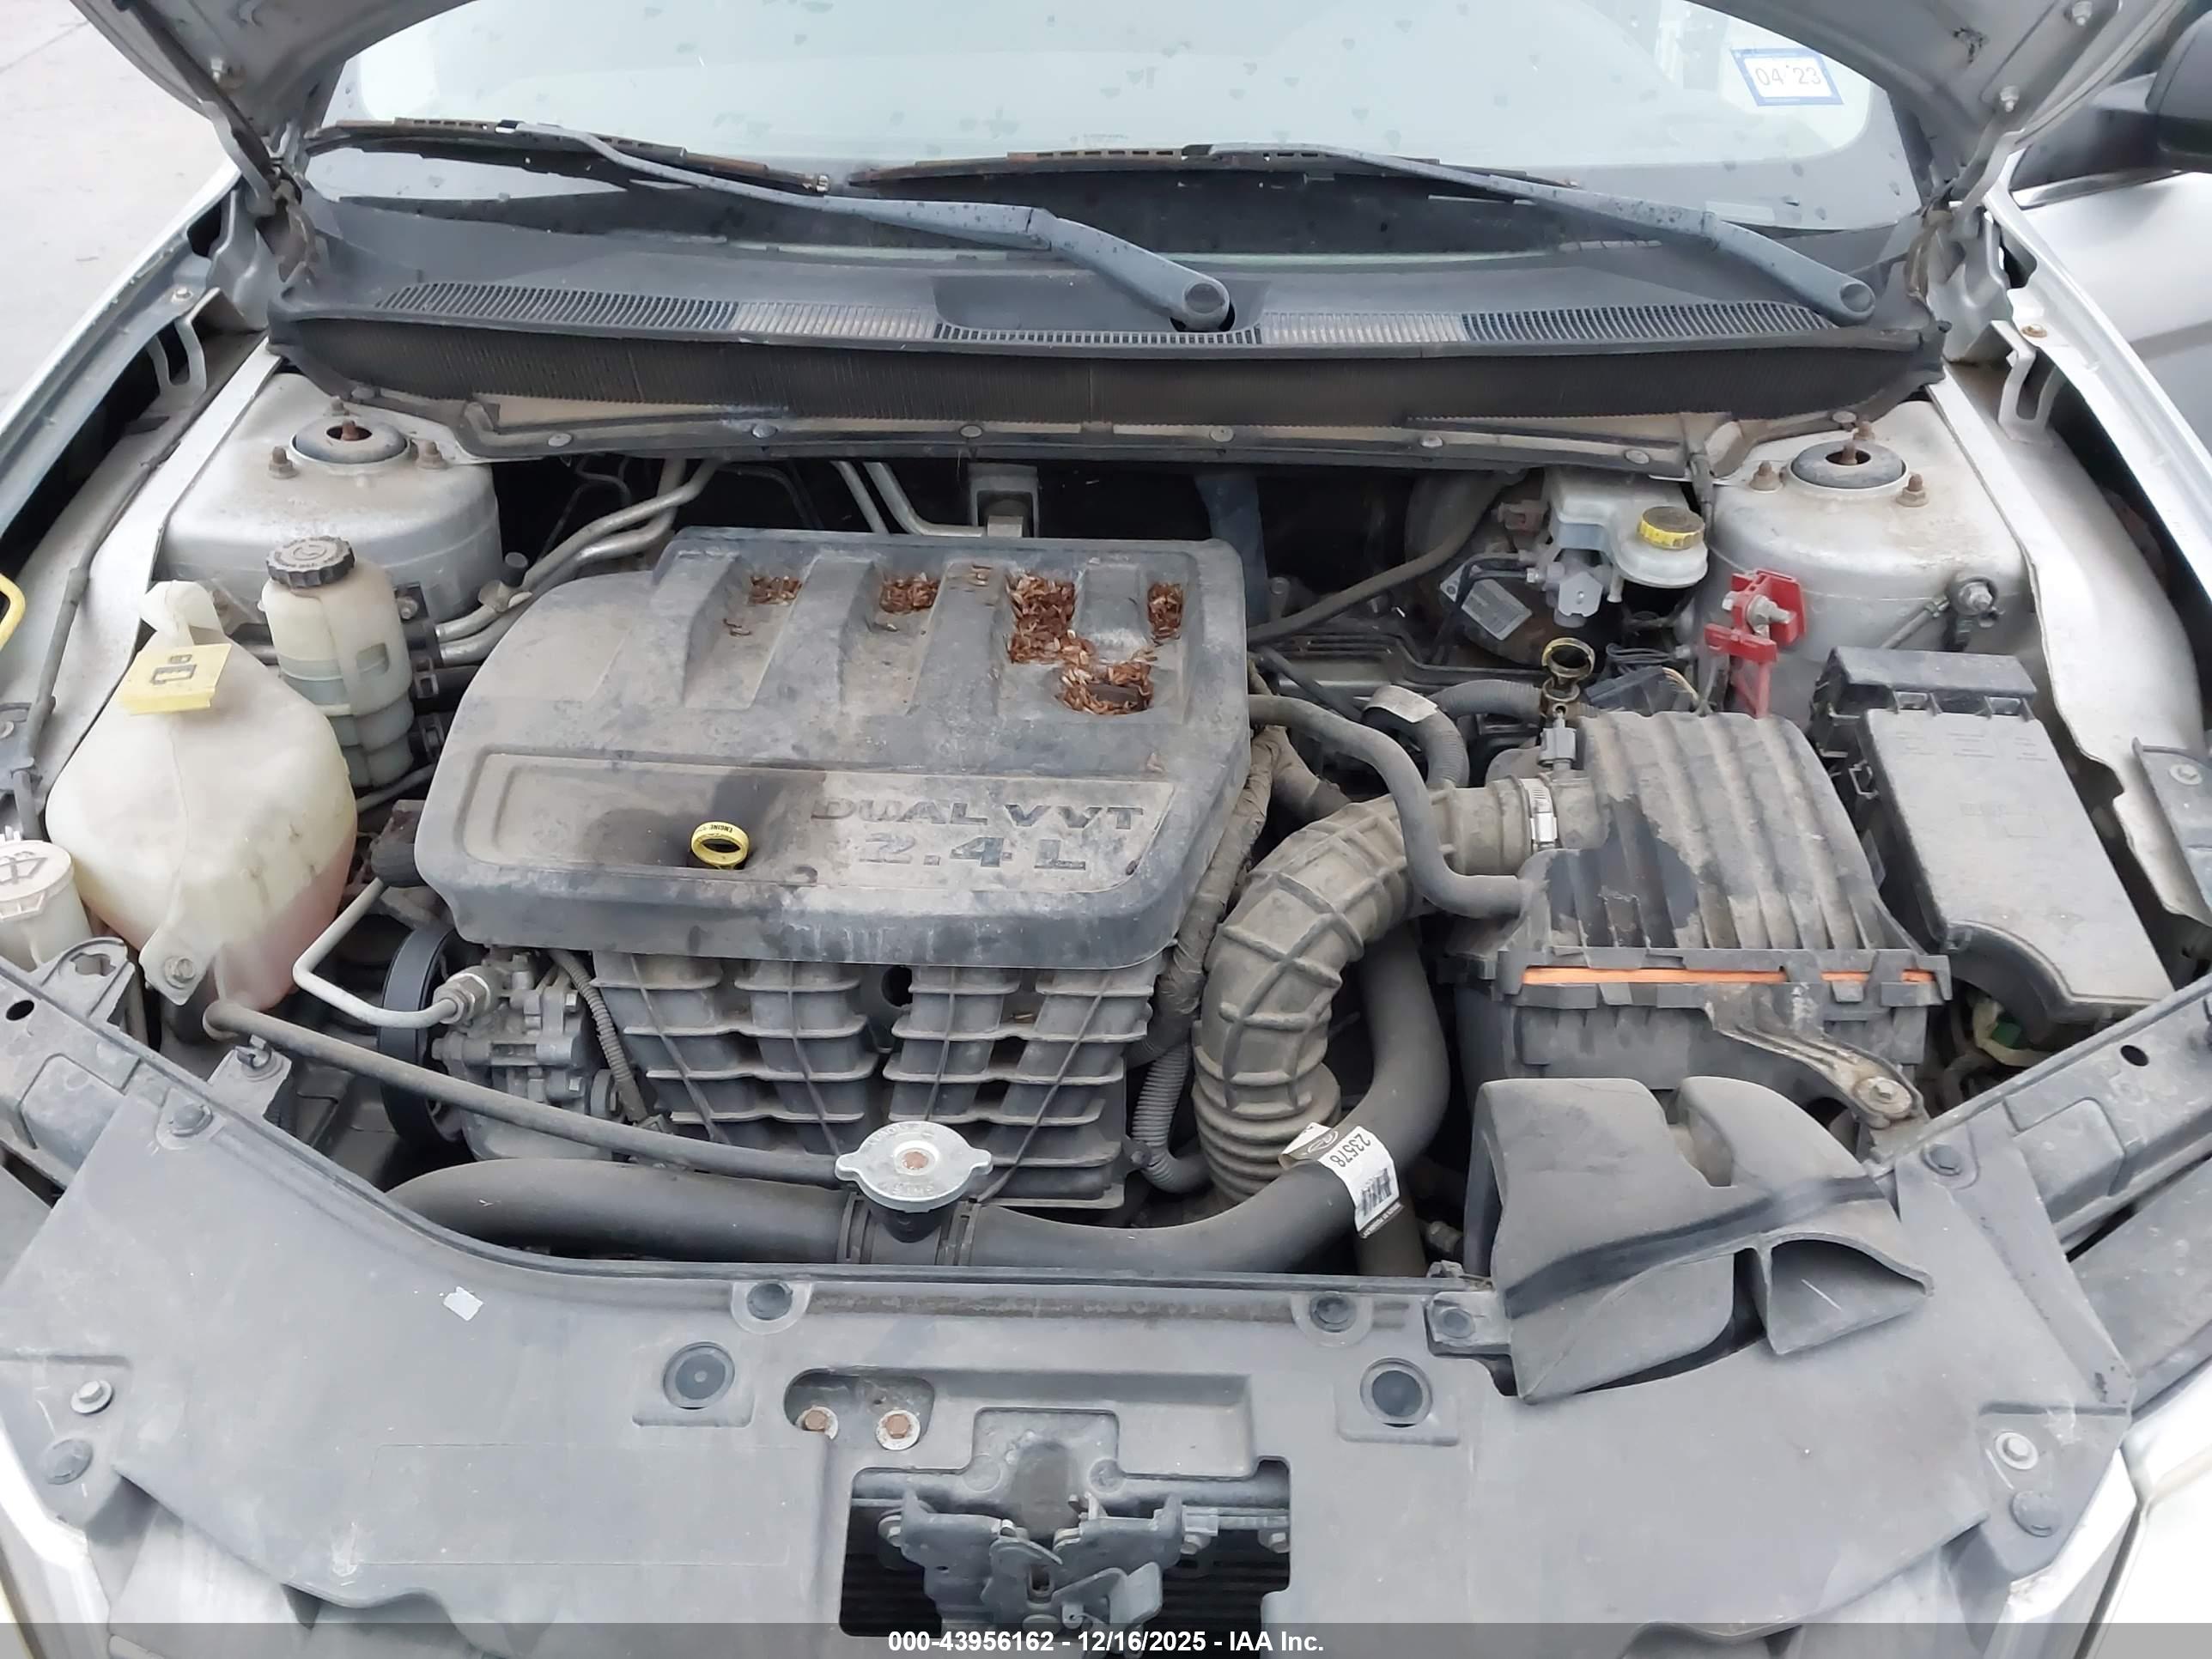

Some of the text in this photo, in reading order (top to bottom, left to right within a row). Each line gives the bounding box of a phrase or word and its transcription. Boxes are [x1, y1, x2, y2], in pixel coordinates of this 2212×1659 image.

[1754, 67, 1784, 86] 04
[811, 798, 1145, 830] DUAL VVT
[1328, 1133, 1372, 1168] 23578
